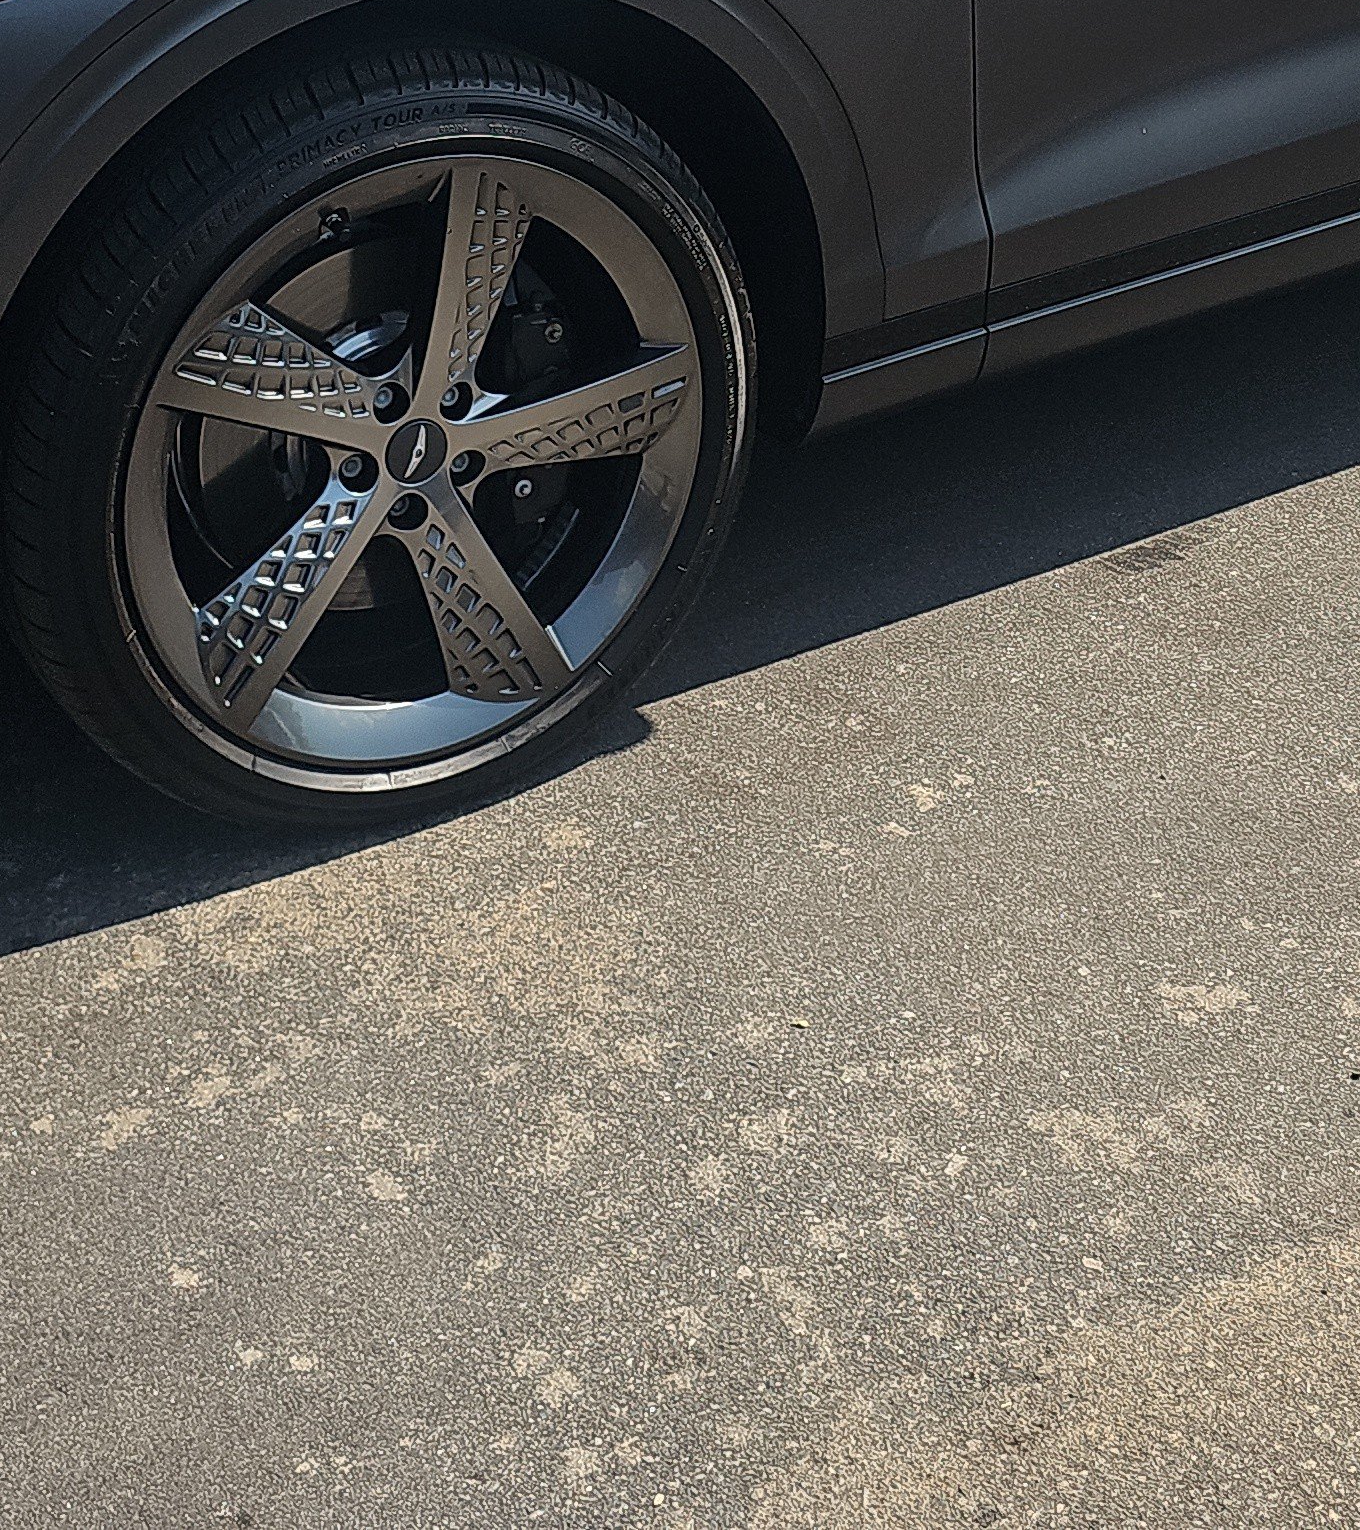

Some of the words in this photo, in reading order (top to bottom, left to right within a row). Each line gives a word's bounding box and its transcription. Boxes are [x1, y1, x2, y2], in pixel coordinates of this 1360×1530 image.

[276, 123, 362, 174] PRIMACY
[371, 107, 424, 134] TOUR
[430, 103, 456, 116] A/S
